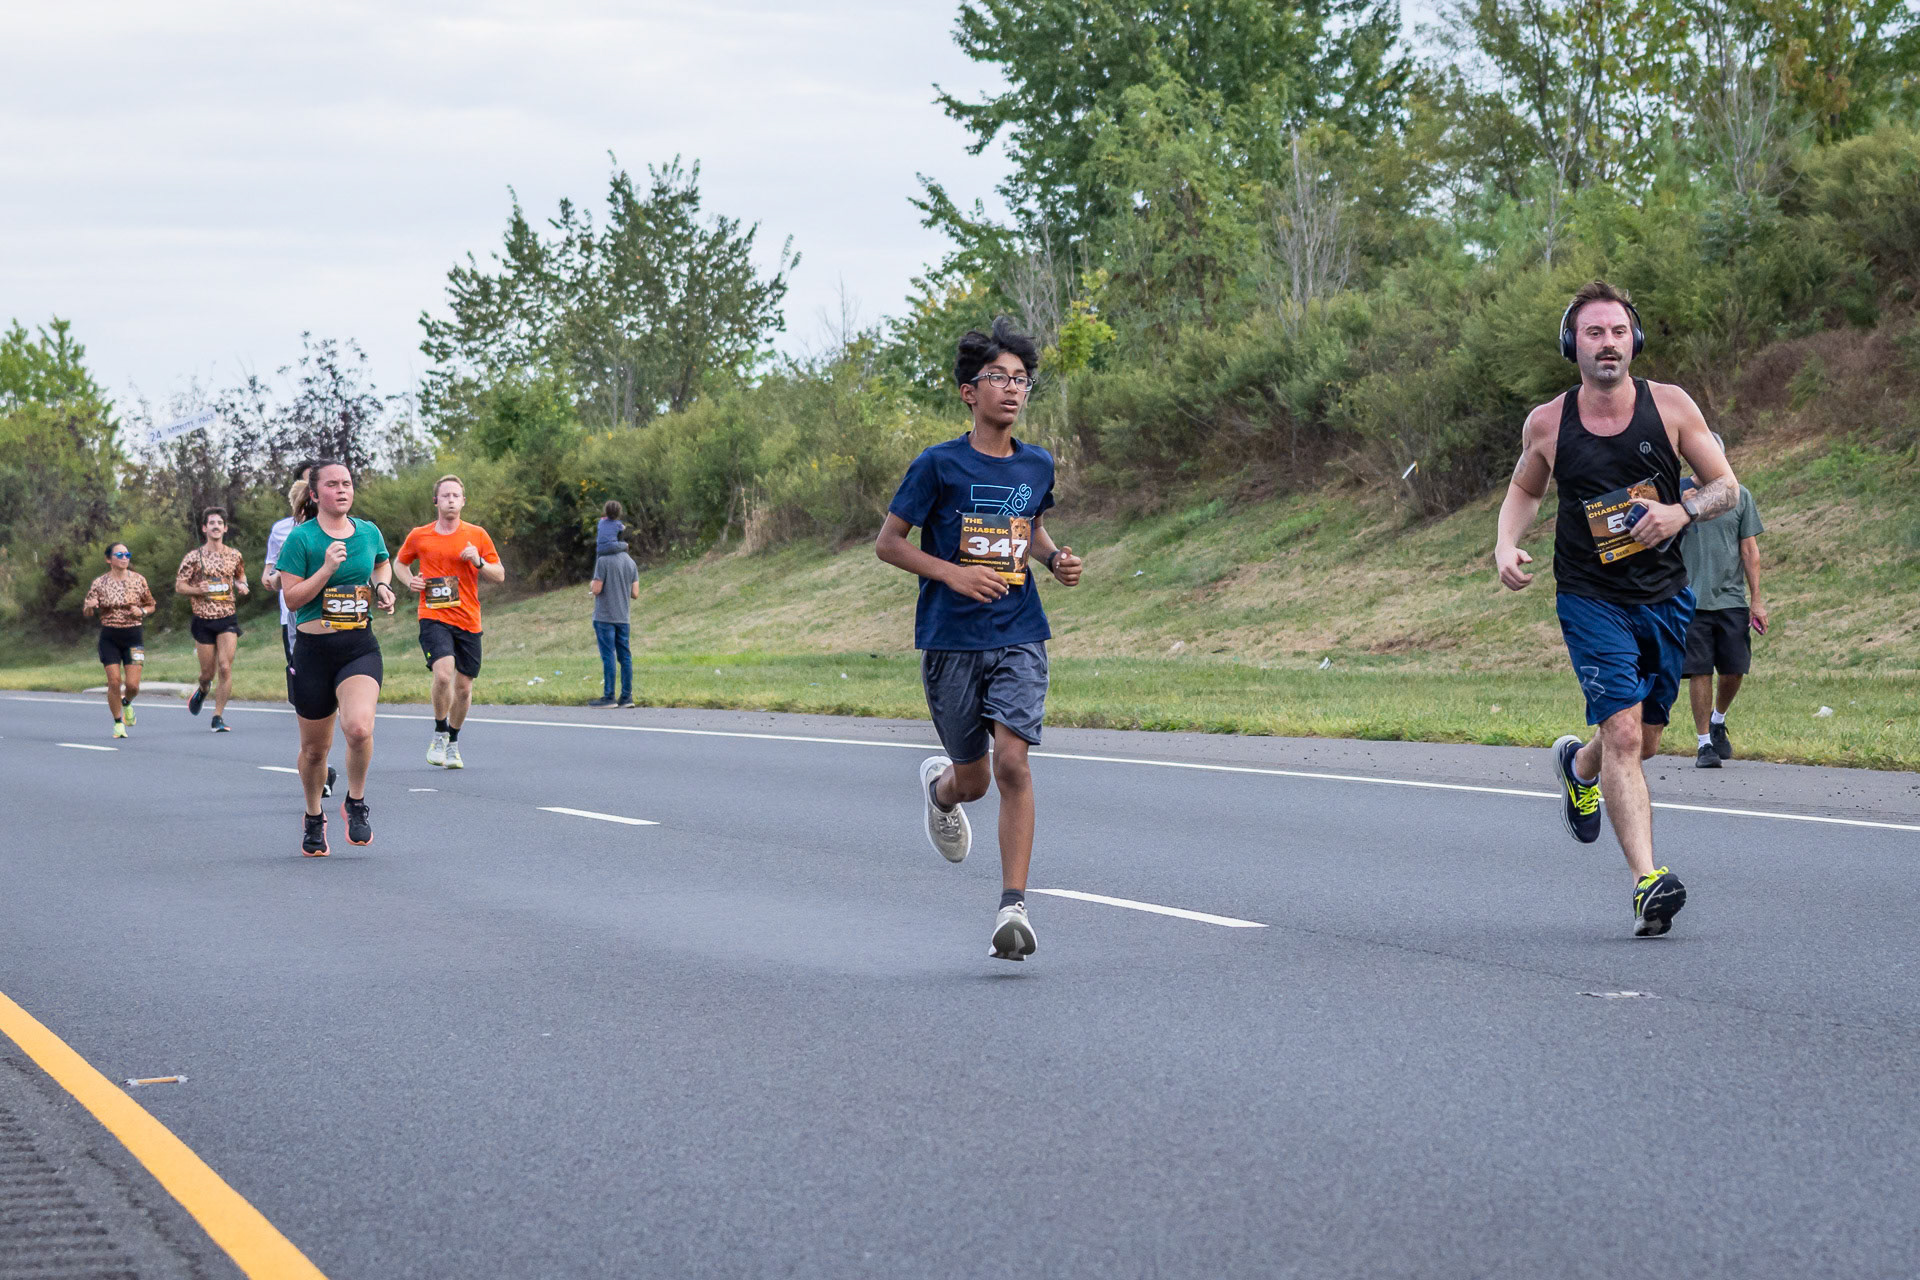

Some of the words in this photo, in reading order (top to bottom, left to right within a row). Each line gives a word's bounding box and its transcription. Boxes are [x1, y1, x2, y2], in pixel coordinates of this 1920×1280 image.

[149, 430, 162, 443] 24
[1586, 501, 1603, 511] THE
[1588, 506, 1618, 519] CHASE
[963, 517, 984, 525] THE
[963, 526, 995, 535] CHASE
[967, 536, 1028, 558] 347
[431, 586, 451, 597] 90
[327, 599, 368, 613] 322
